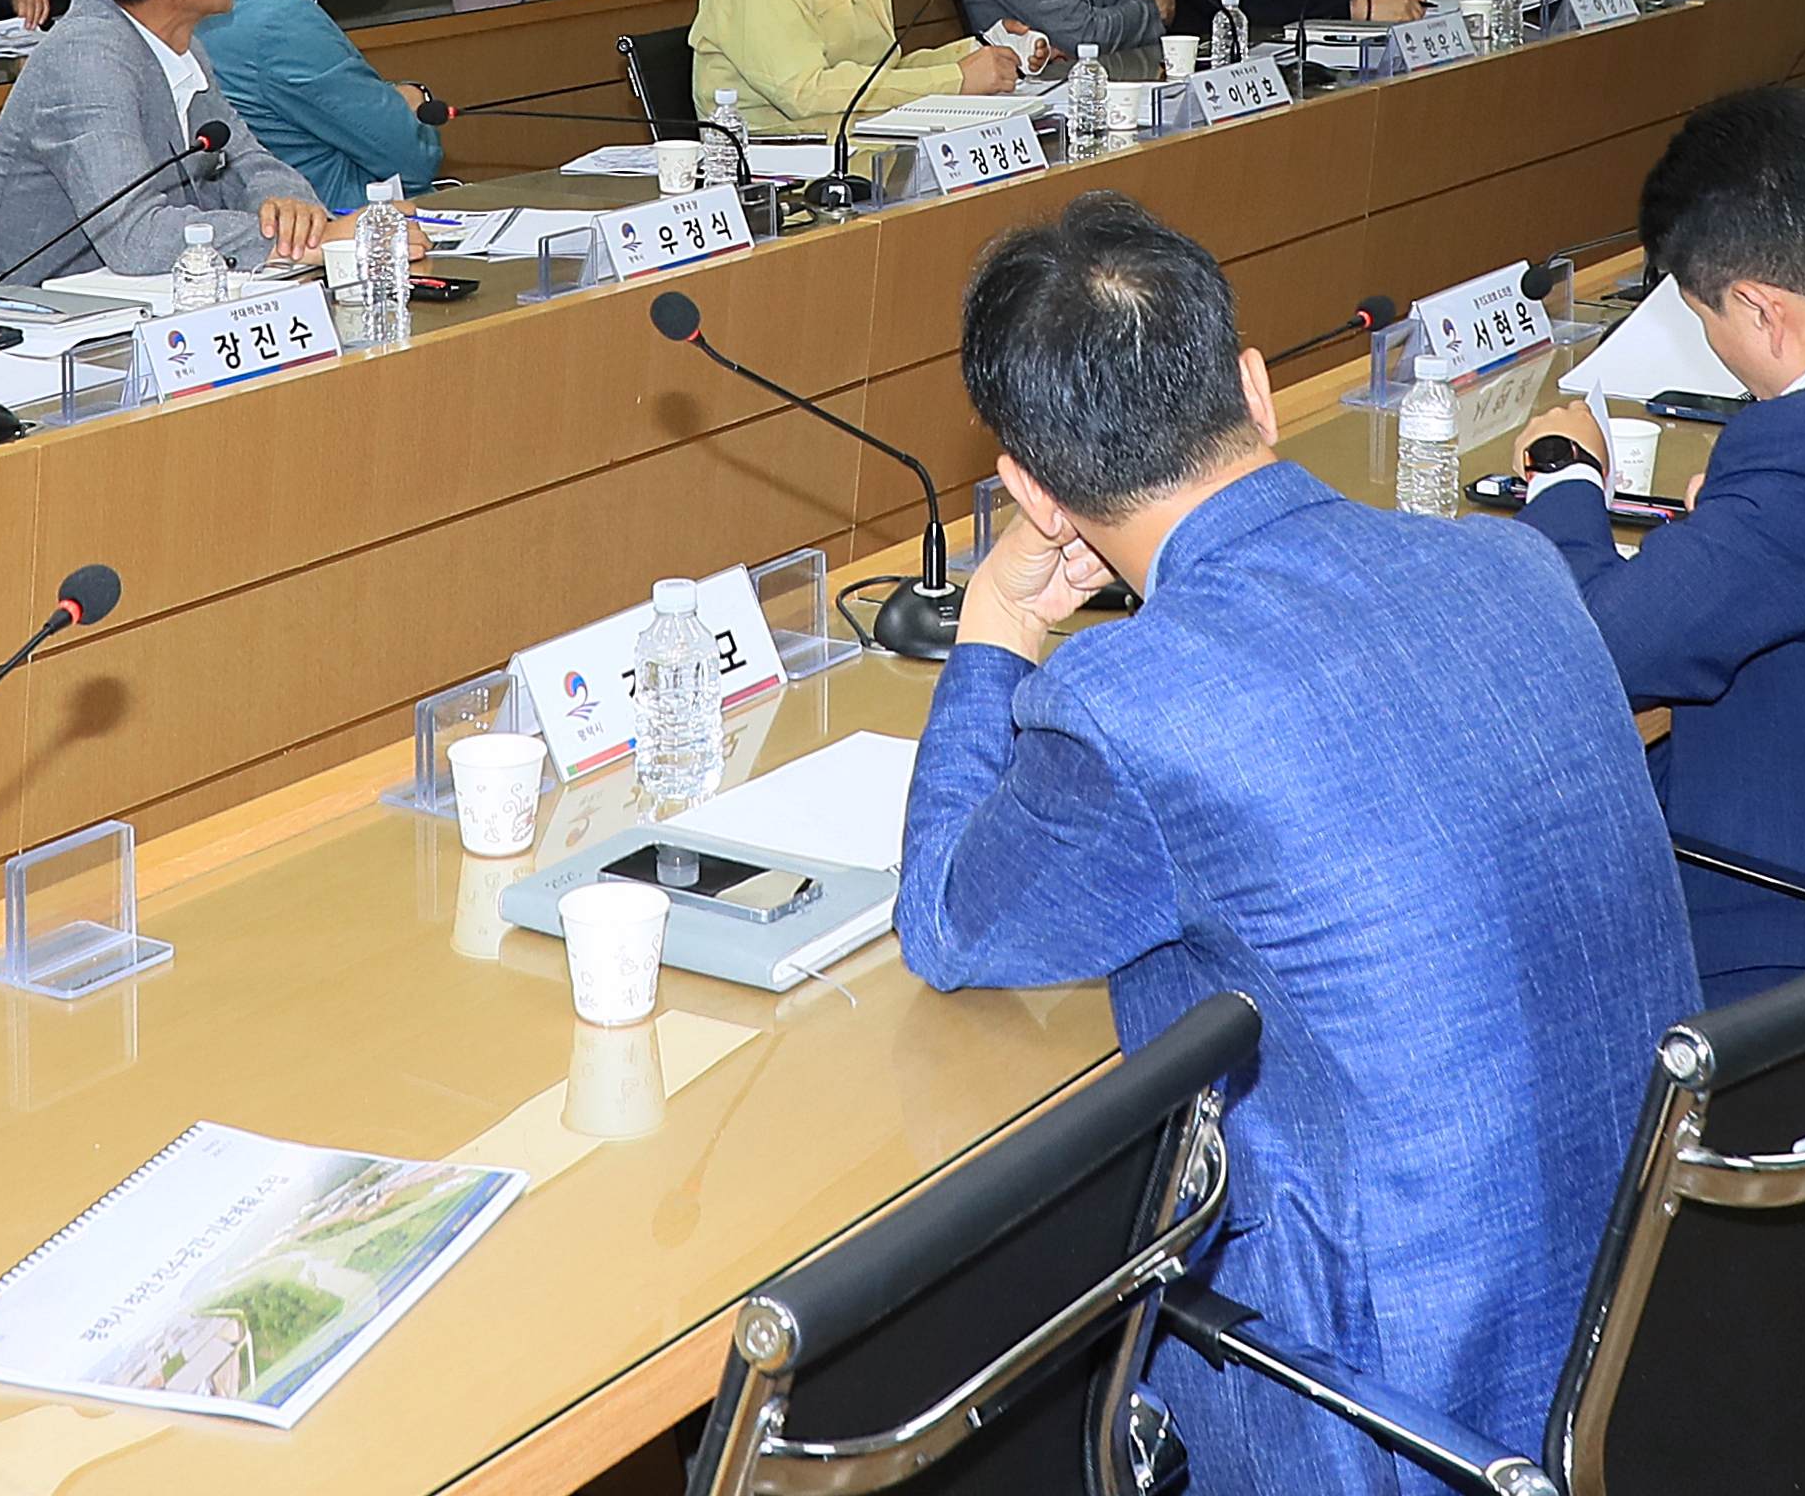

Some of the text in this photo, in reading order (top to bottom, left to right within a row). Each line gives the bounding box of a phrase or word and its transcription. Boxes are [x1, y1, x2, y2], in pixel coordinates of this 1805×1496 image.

[1422, 30, 1466, 59] 한우식
[1228, 76, 1278, 107] 이성호
[969, 137, 1031, 176] 정장선
[658, 211, 733, 256] 우정식
[229, 300, 280, 321] 생태하천과장
[1473, 301, 1537, 352] 서현옥
[213, 316, 313, 370] 장진수
[576, 721, 605, 742] 평택시
[79, 1304, 136, 1342] 평택시
